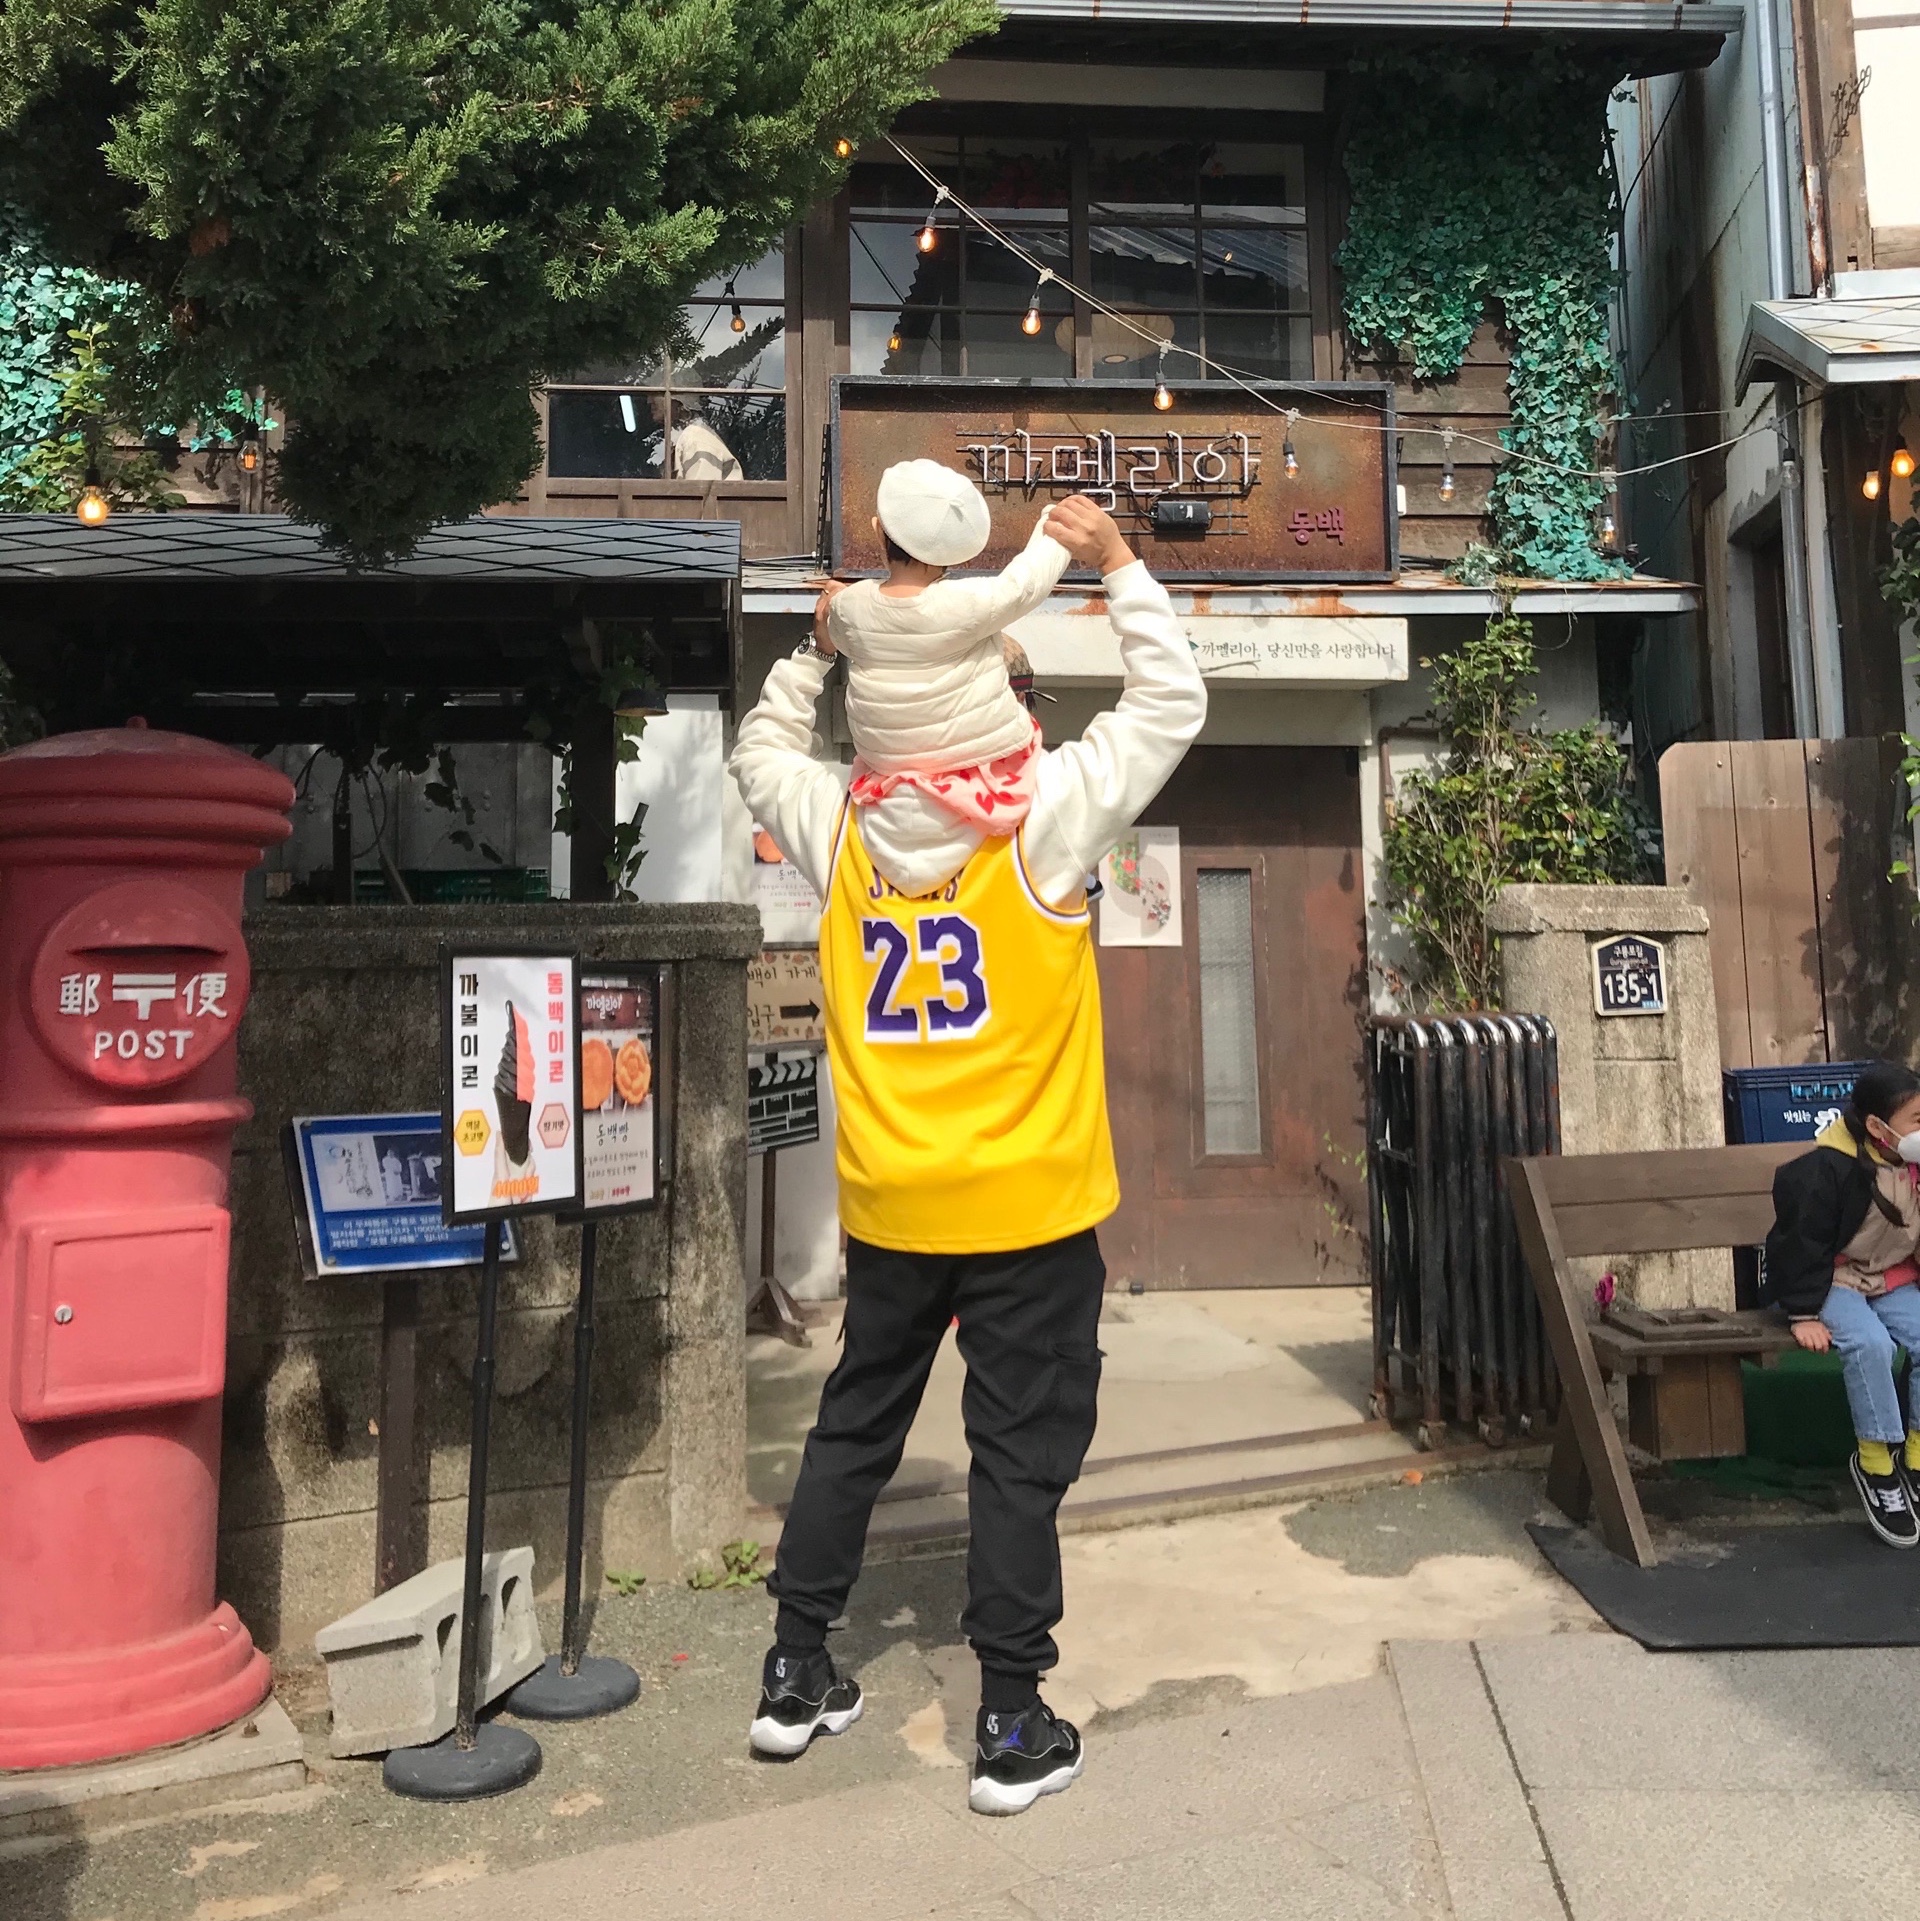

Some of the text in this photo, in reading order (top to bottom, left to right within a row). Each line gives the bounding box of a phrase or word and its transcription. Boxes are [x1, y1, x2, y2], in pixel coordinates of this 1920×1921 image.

[967, 429, 1262, 512] 까멜리아
[1287, 507, 1345, 546] 동백
[1201, 642, 1395, 660] 까멜리아, 당신만을 사랑합니다
[786, 966, 816, 980] 가게
[861, 911, 992, 1044] 23
[1603, 972, 1659, 1004] 135-1
[547, 972, 564, 1083] 동백이콘
[94, 1029, 194, 1060] POST
[596, 1121, 629, 1146] 동백빵
